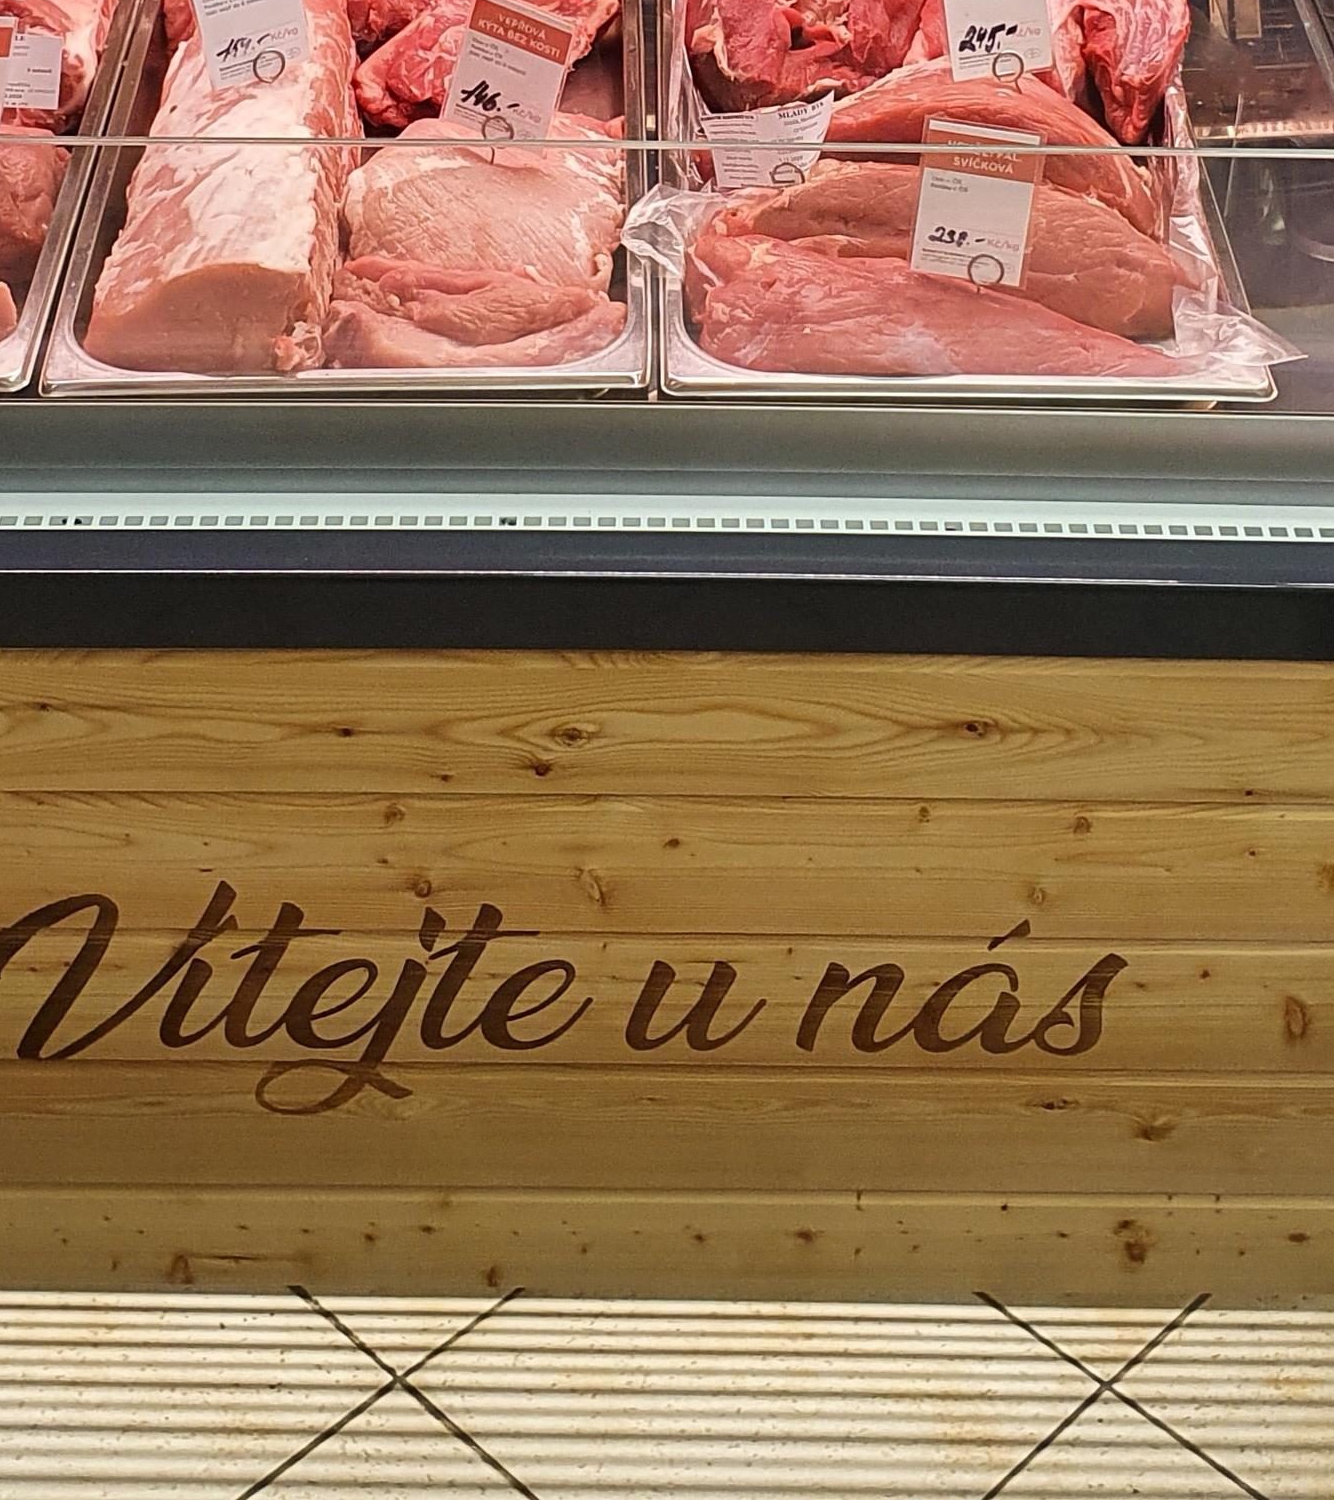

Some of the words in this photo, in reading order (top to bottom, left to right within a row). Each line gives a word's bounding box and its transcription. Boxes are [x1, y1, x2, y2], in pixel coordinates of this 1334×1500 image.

[477, 17, 506, 38] KÝTA
[506, 27, 528, 48] BEZ
[498, 11, 547, 41] VEPŘOVÁ
[952, 155, 1014, 174] SVÍČKOVÁ
[623, 956, 766, 1054] u
[794, 918, 1129, 1057] nás
